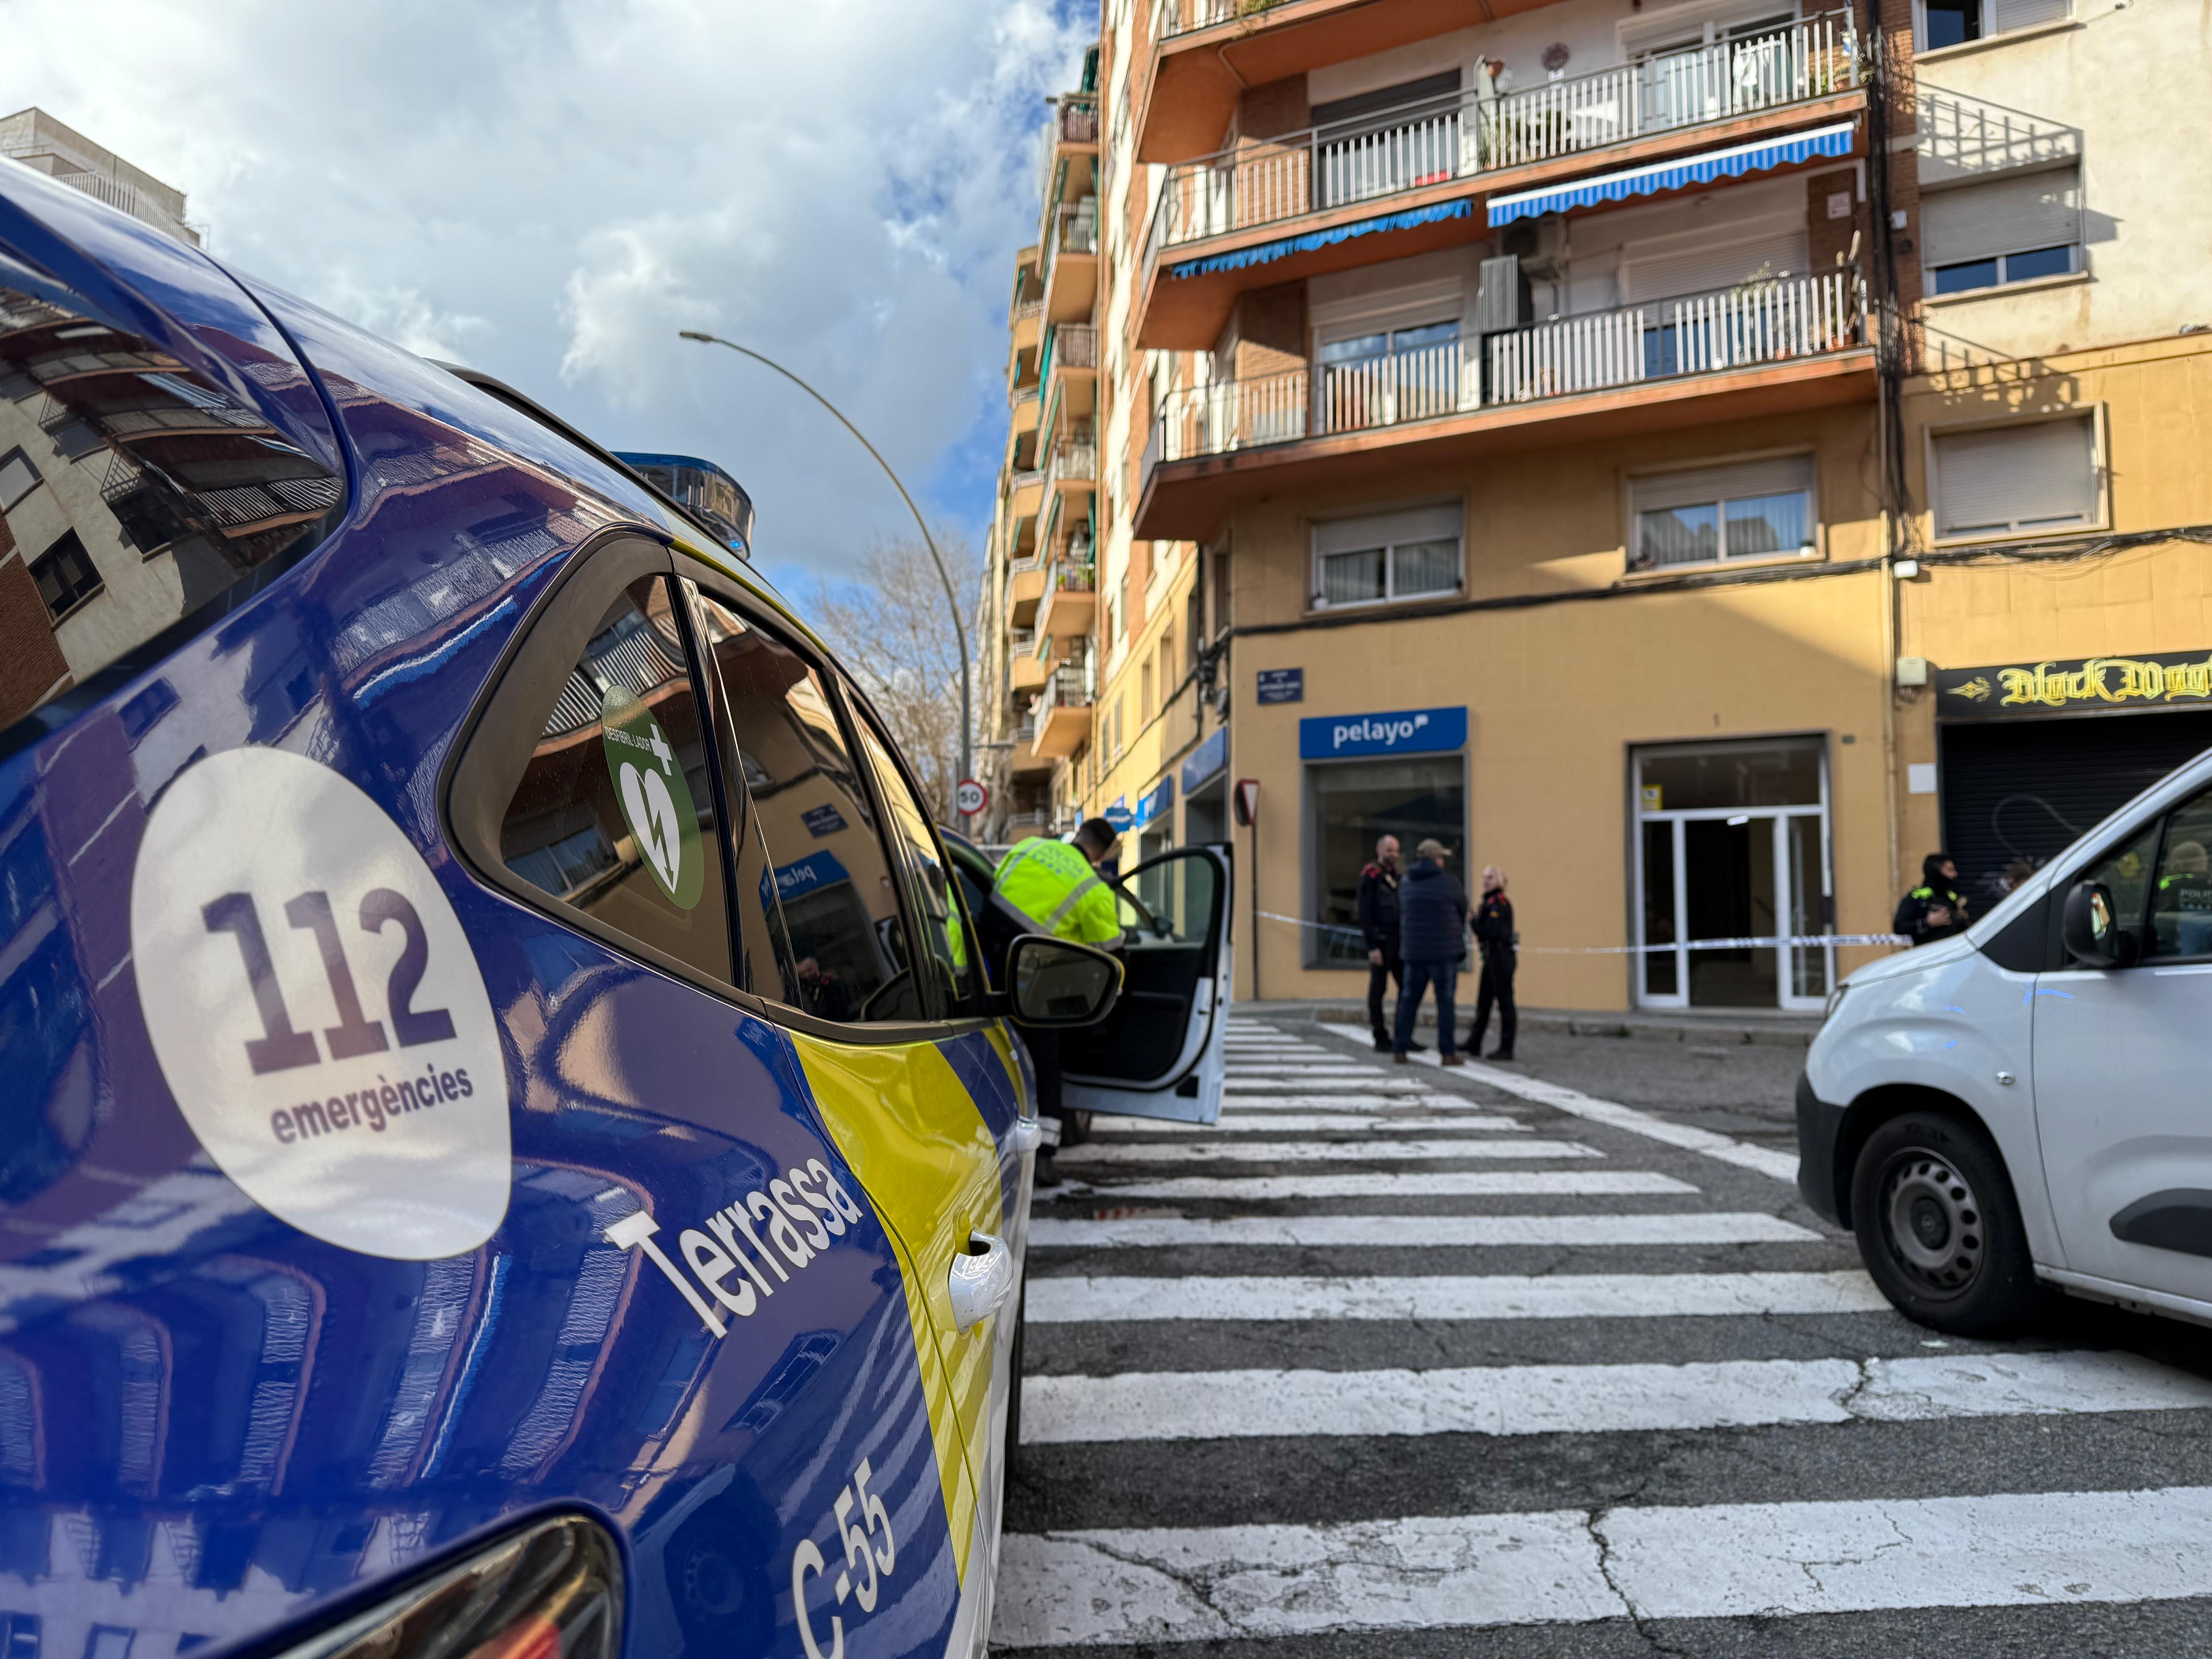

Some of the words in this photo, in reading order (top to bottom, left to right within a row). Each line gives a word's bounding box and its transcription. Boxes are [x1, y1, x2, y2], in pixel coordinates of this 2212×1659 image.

[960, 790, 980, 804] 50
[1333, 718, 1414, 750] pelayo
[200, 887, 458, 1076] 112
[270, 1062, 474, 1144] emergències
[605, 1158, 863, 1339] Terrassa
[792, 1456, 895, 1659] C-55
